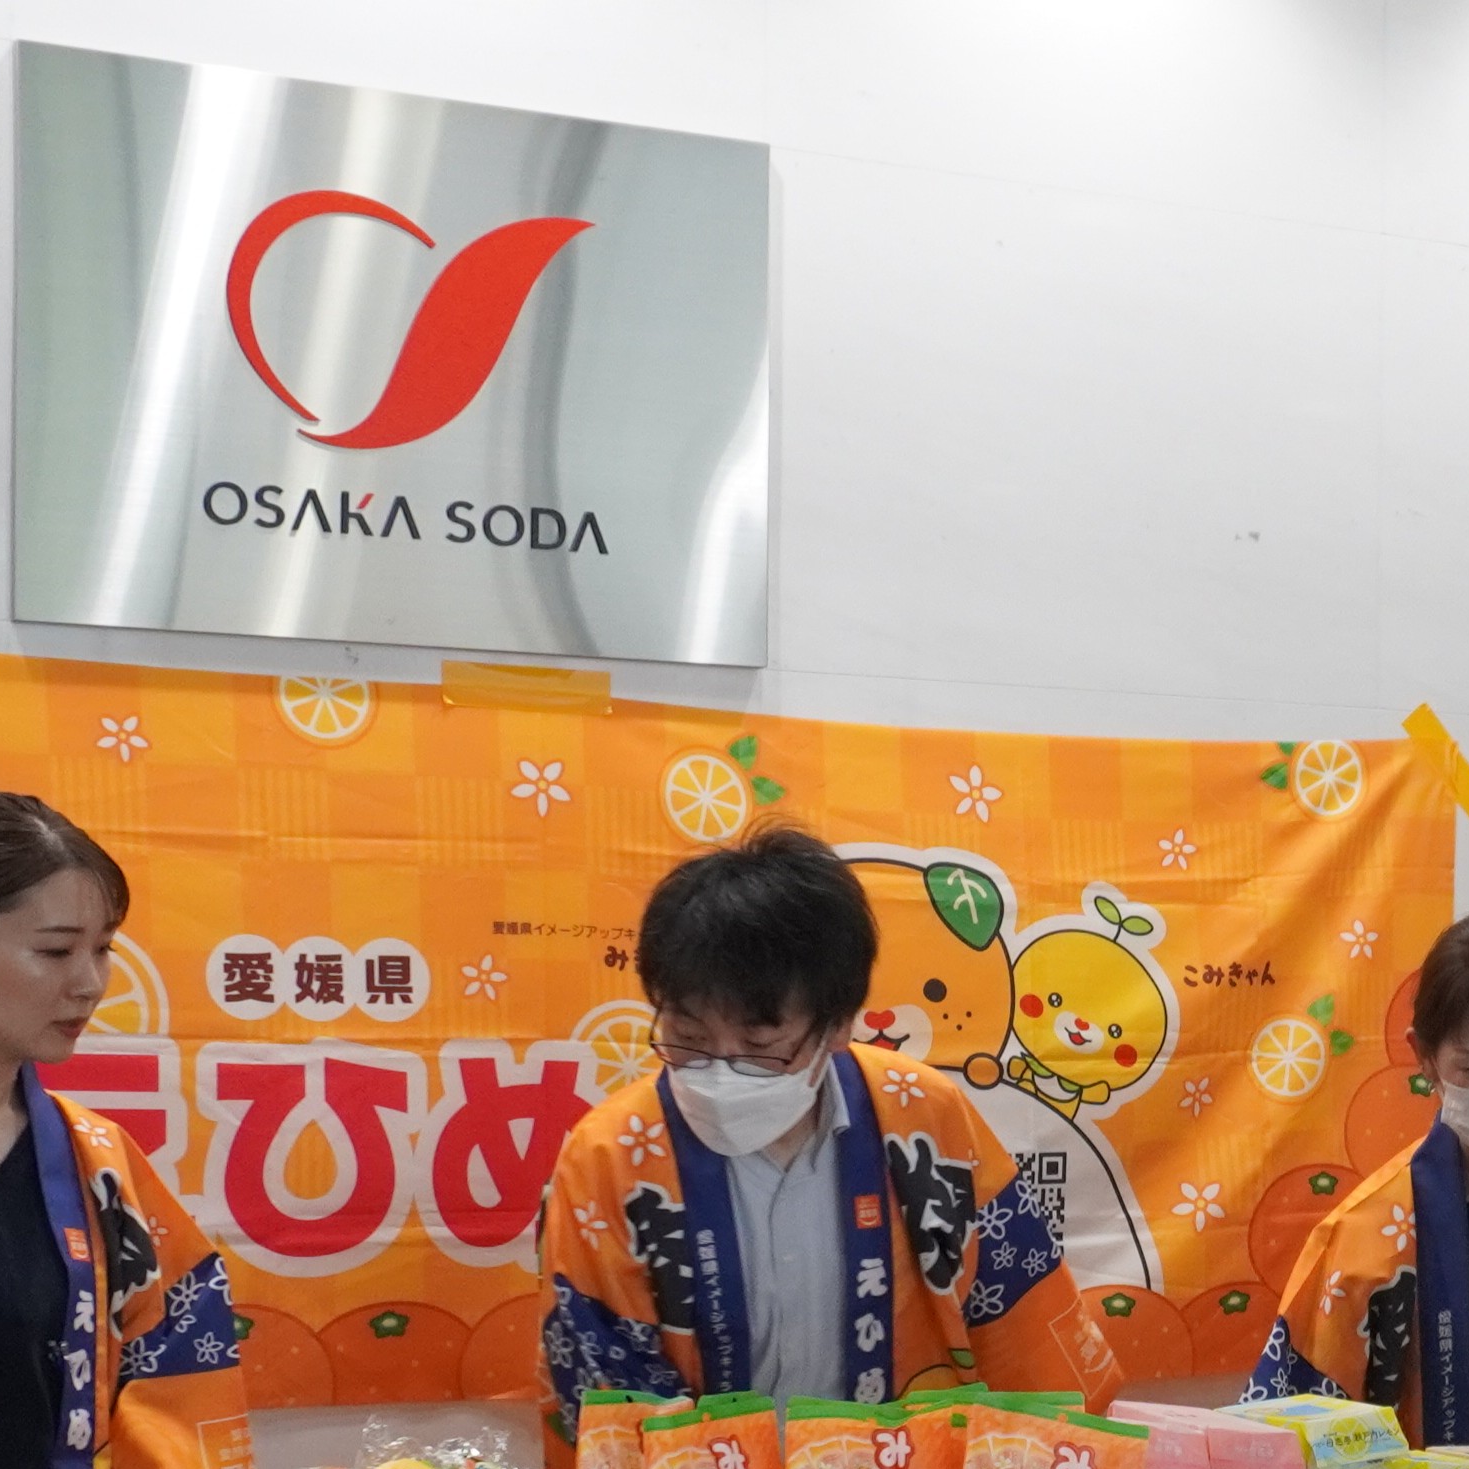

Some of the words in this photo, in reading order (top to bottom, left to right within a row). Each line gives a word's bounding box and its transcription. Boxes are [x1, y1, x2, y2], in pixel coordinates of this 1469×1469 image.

[203, 481, 421, 540] OSAKA
[445, 501, 609, 555] SODA
[222, 951, 414, 1006] 愛媛県
[1183, 961, 1275, 989] こみきゃん
[856, 1257, 888, 1403] えひめ
